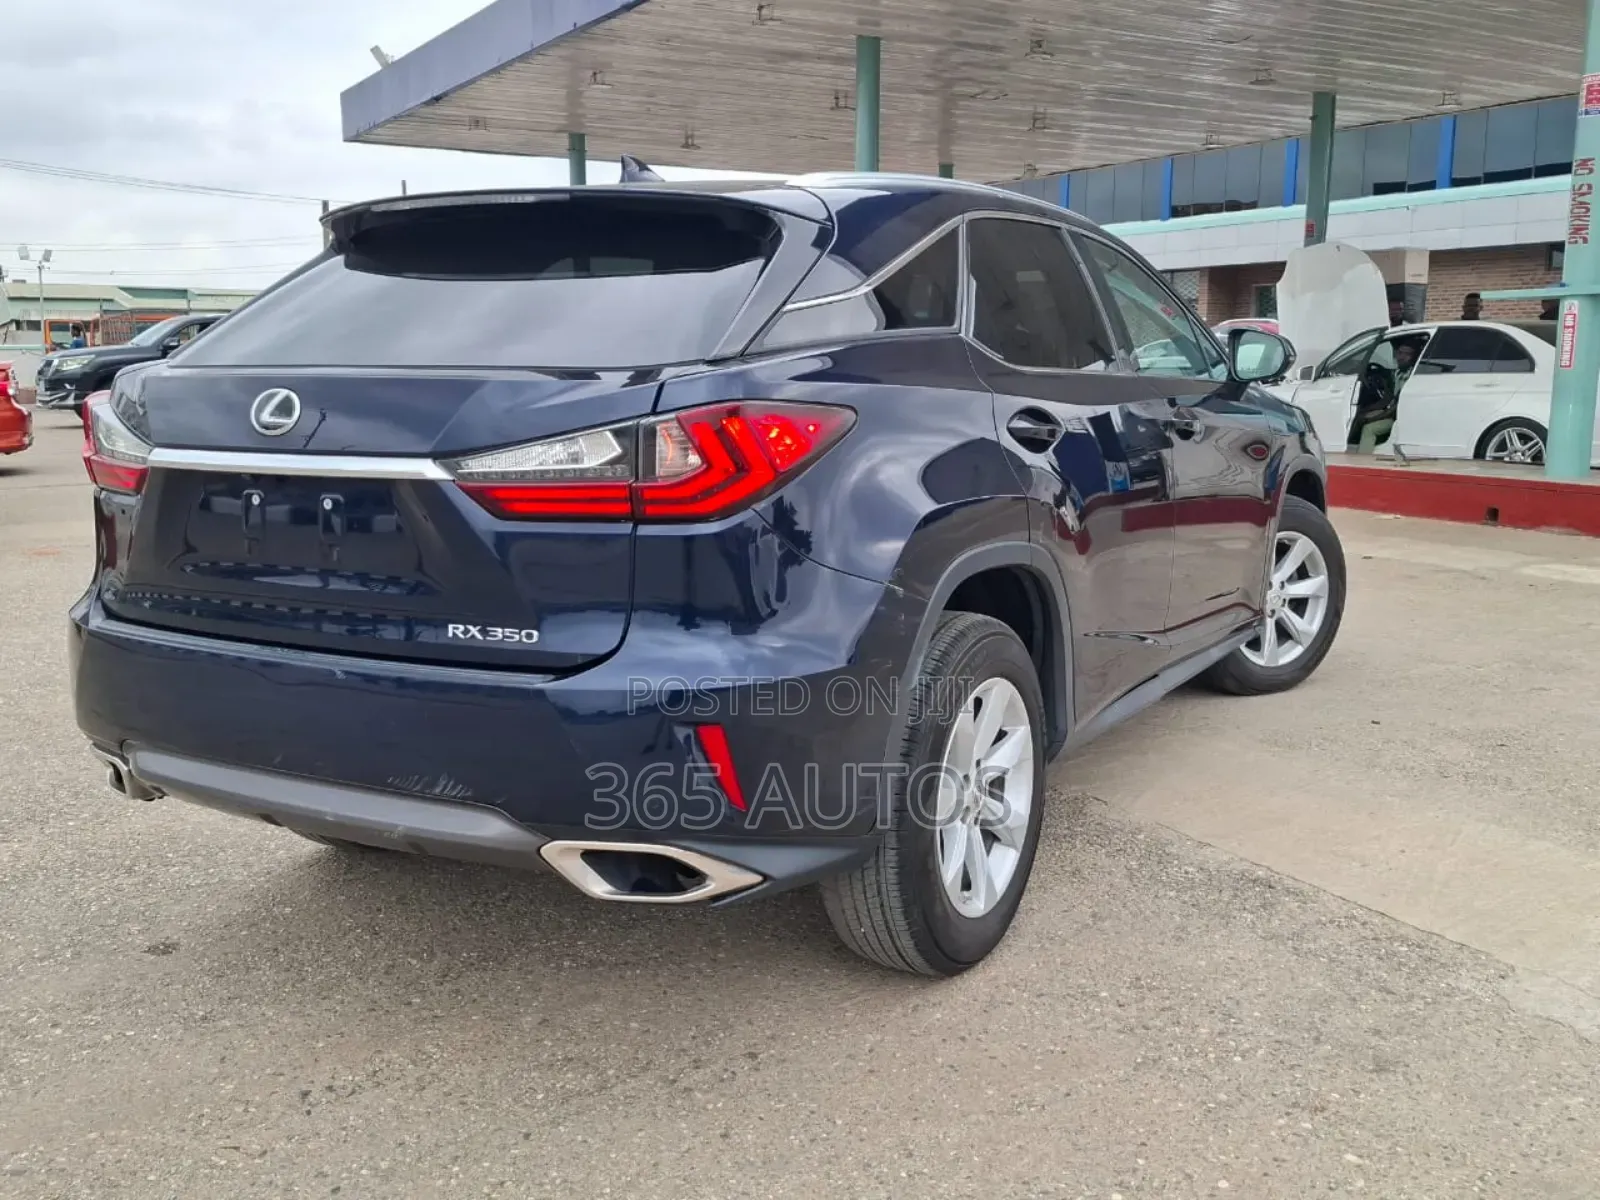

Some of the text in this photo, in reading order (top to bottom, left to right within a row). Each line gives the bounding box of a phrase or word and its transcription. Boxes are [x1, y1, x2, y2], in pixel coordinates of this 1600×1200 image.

[1568, 157, 1595, 245] NO SMOKING
[1560, 314, 1575, 366] NO SMOKING
